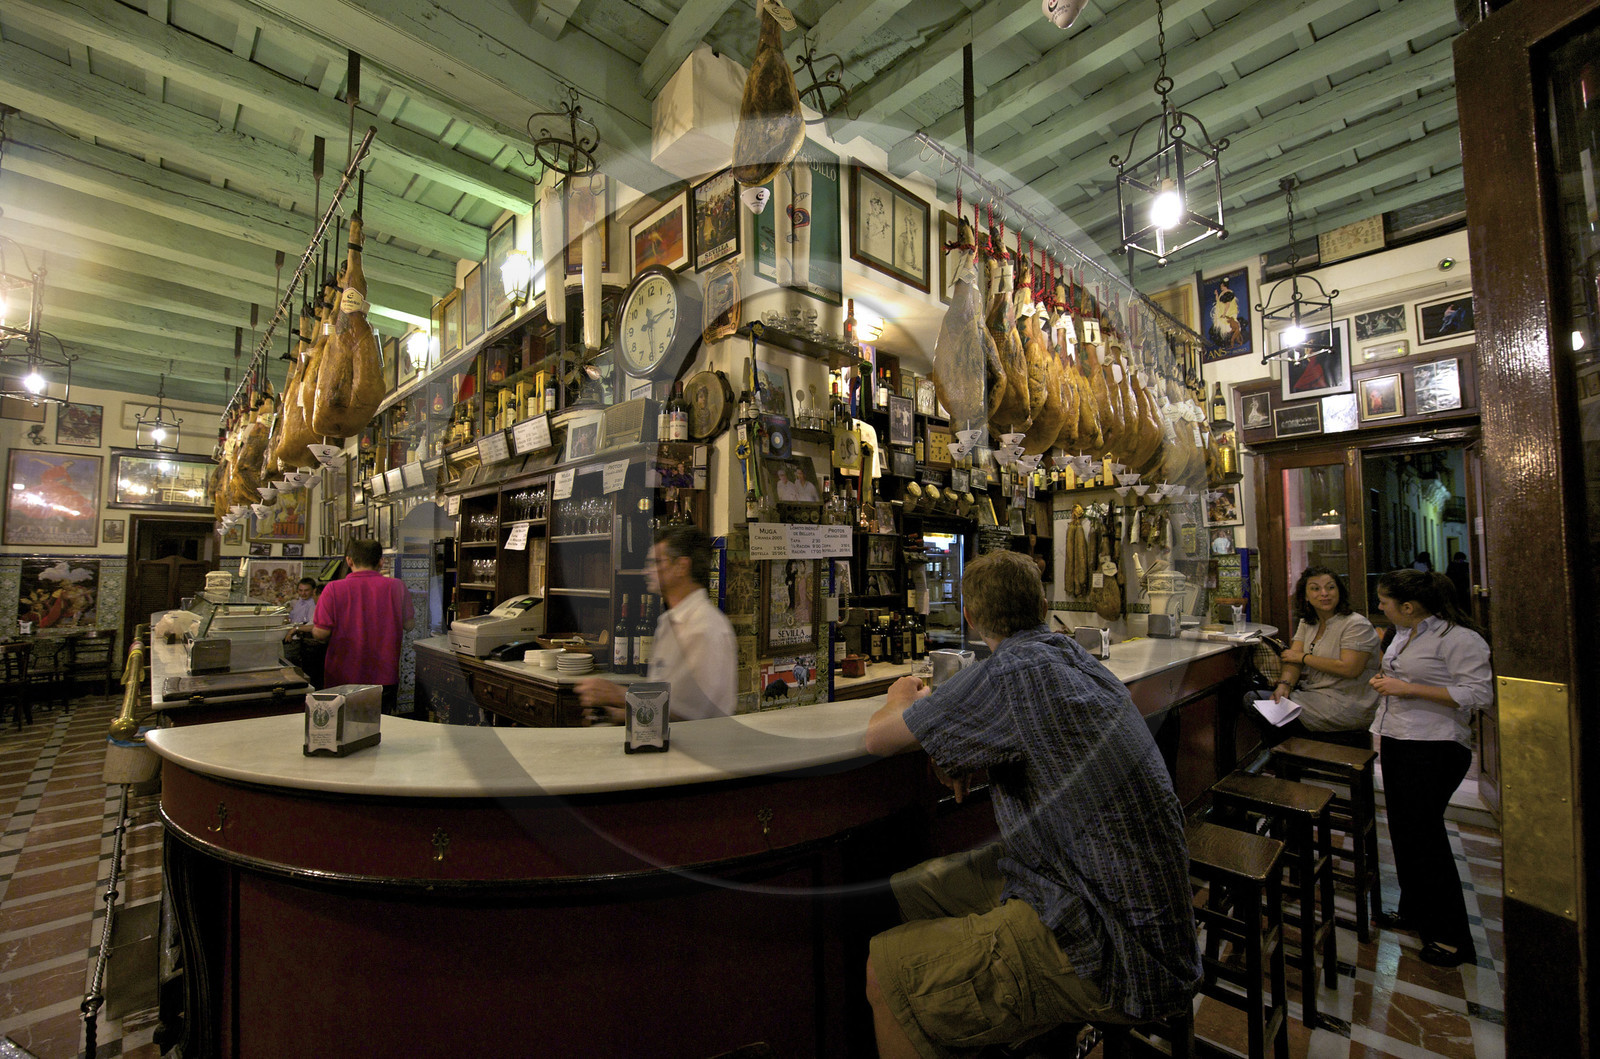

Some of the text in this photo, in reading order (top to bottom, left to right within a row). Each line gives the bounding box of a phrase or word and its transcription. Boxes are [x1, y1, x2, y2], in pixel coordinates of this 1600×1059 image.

[704, 242, 729, 259] SEVILLA
[647, 285, 655, 297] 12
[638, 295, 644, 306] 11
[666, 293, 672, 304] 2
[631, 309, 638, 320] 10
[669, 309, 675, 320] 3
[628, 327, 634, 337] 9
[666, 327, 672, 338] 4
[631, 342, 637, 352] 8
[659, 342, 665, 353] 5
[639, 350, 644, 361] 7
[648, 351, 654, 362] 6
[778, 629, 805, 638] SEVILLA
